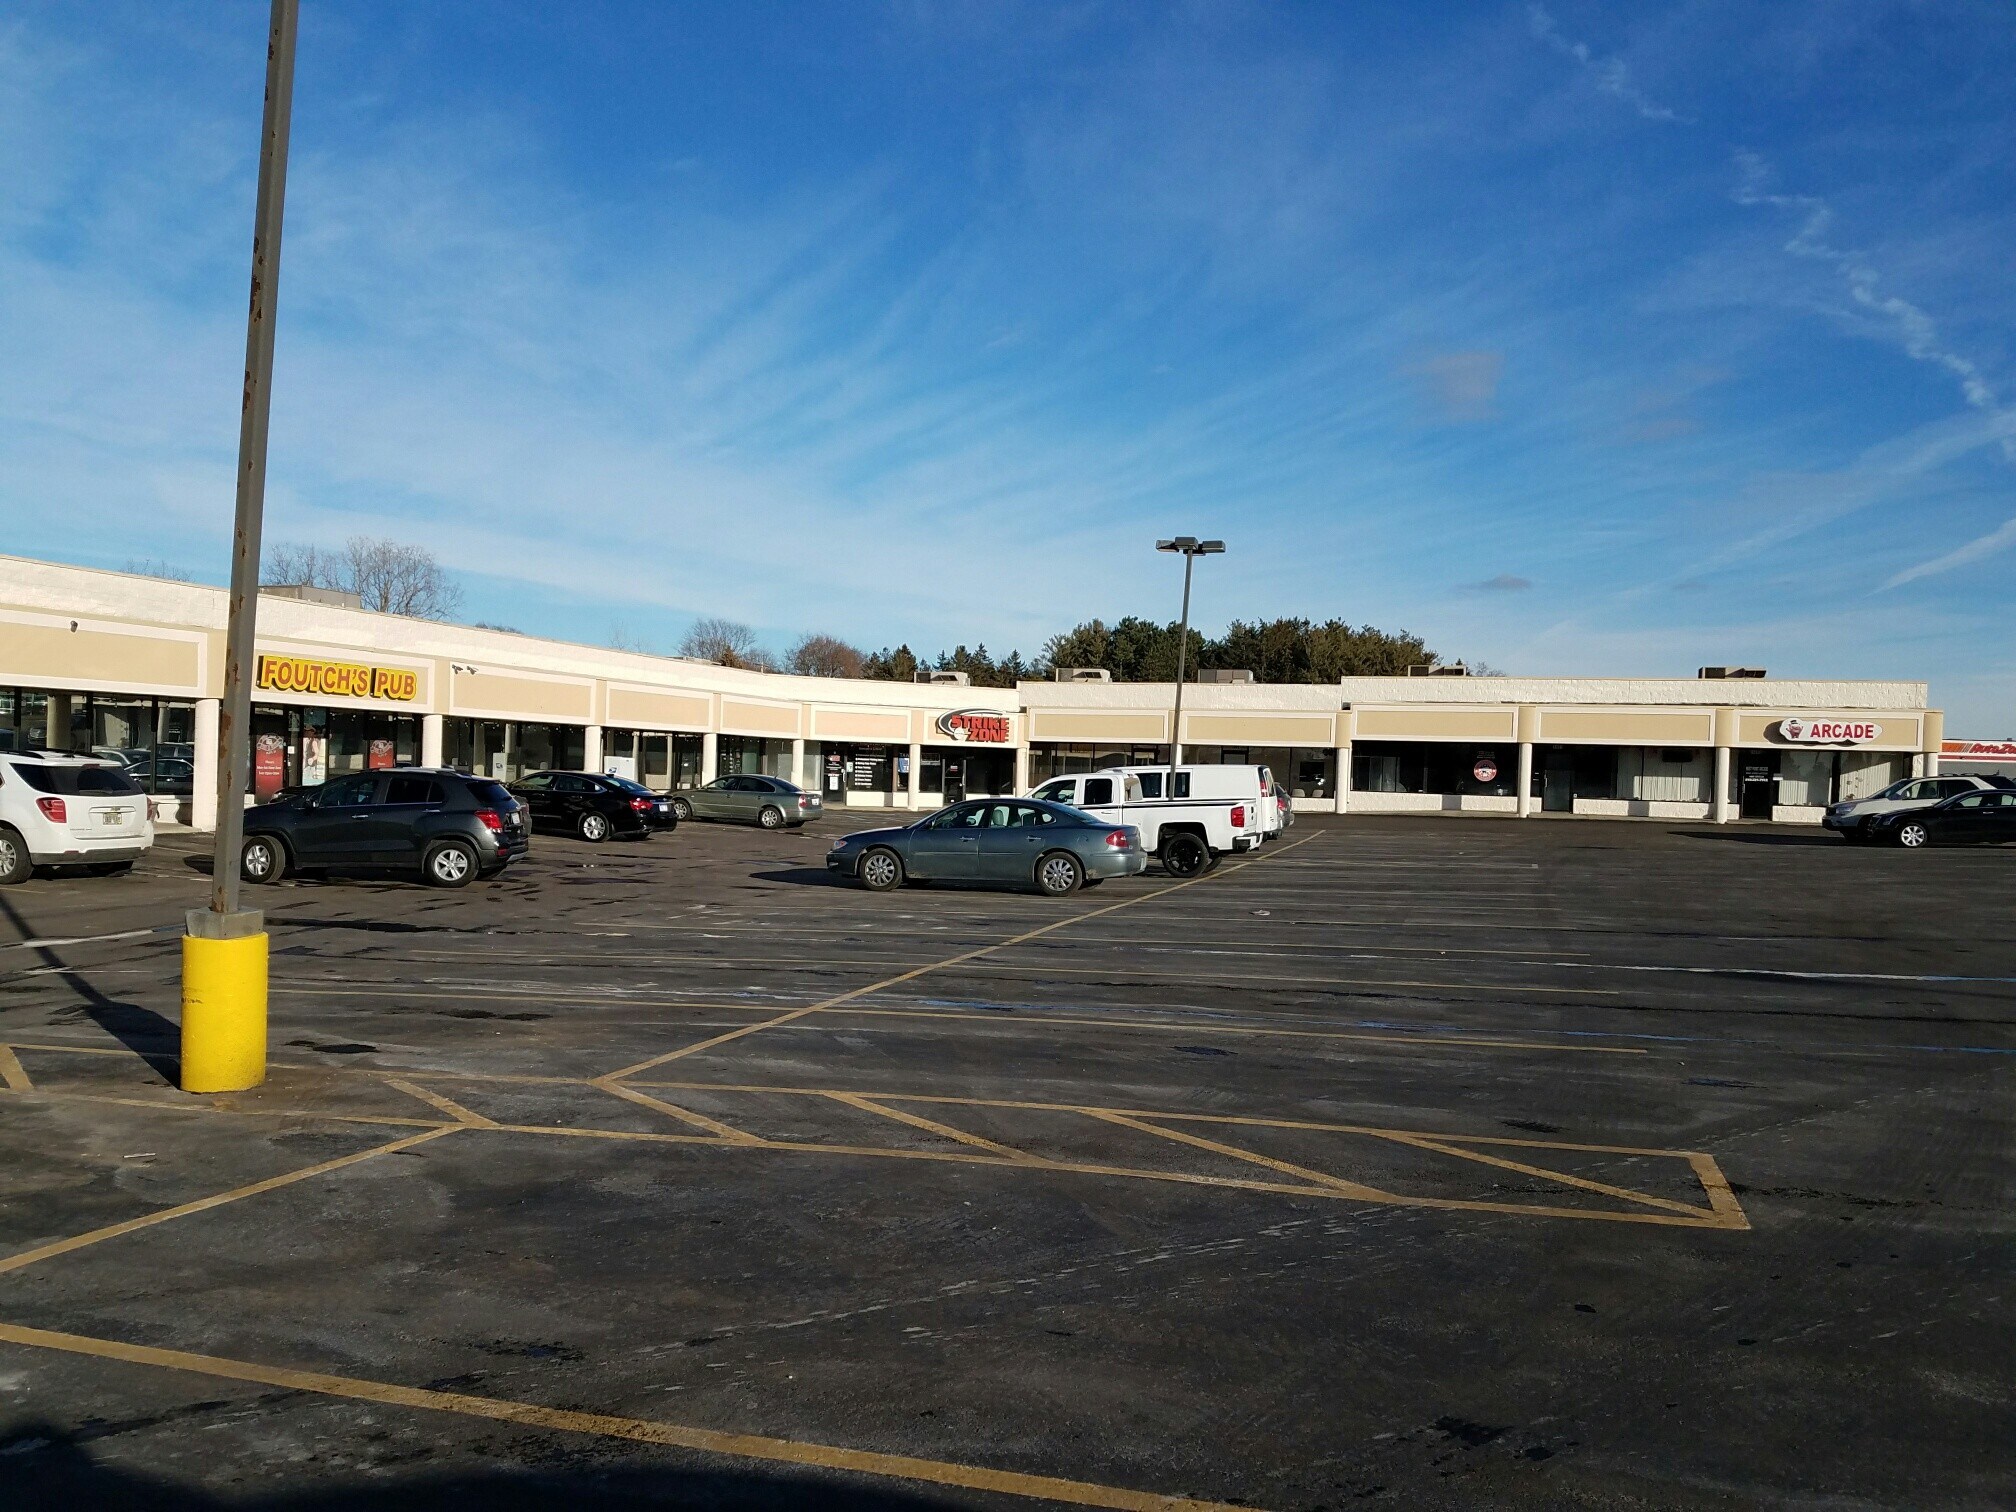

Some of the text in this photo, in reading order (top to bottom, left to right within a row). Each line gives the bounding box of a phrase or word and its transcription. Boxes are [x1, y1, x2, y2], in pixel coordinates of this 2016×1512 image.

[261, 656, 417, 699] FOUTCH'S PUB
[951, 714, 1009, 730] STRIKE
[967, 728, 1008, 743] ZONE
[1810, 723, 1874, 739] ARCADE
